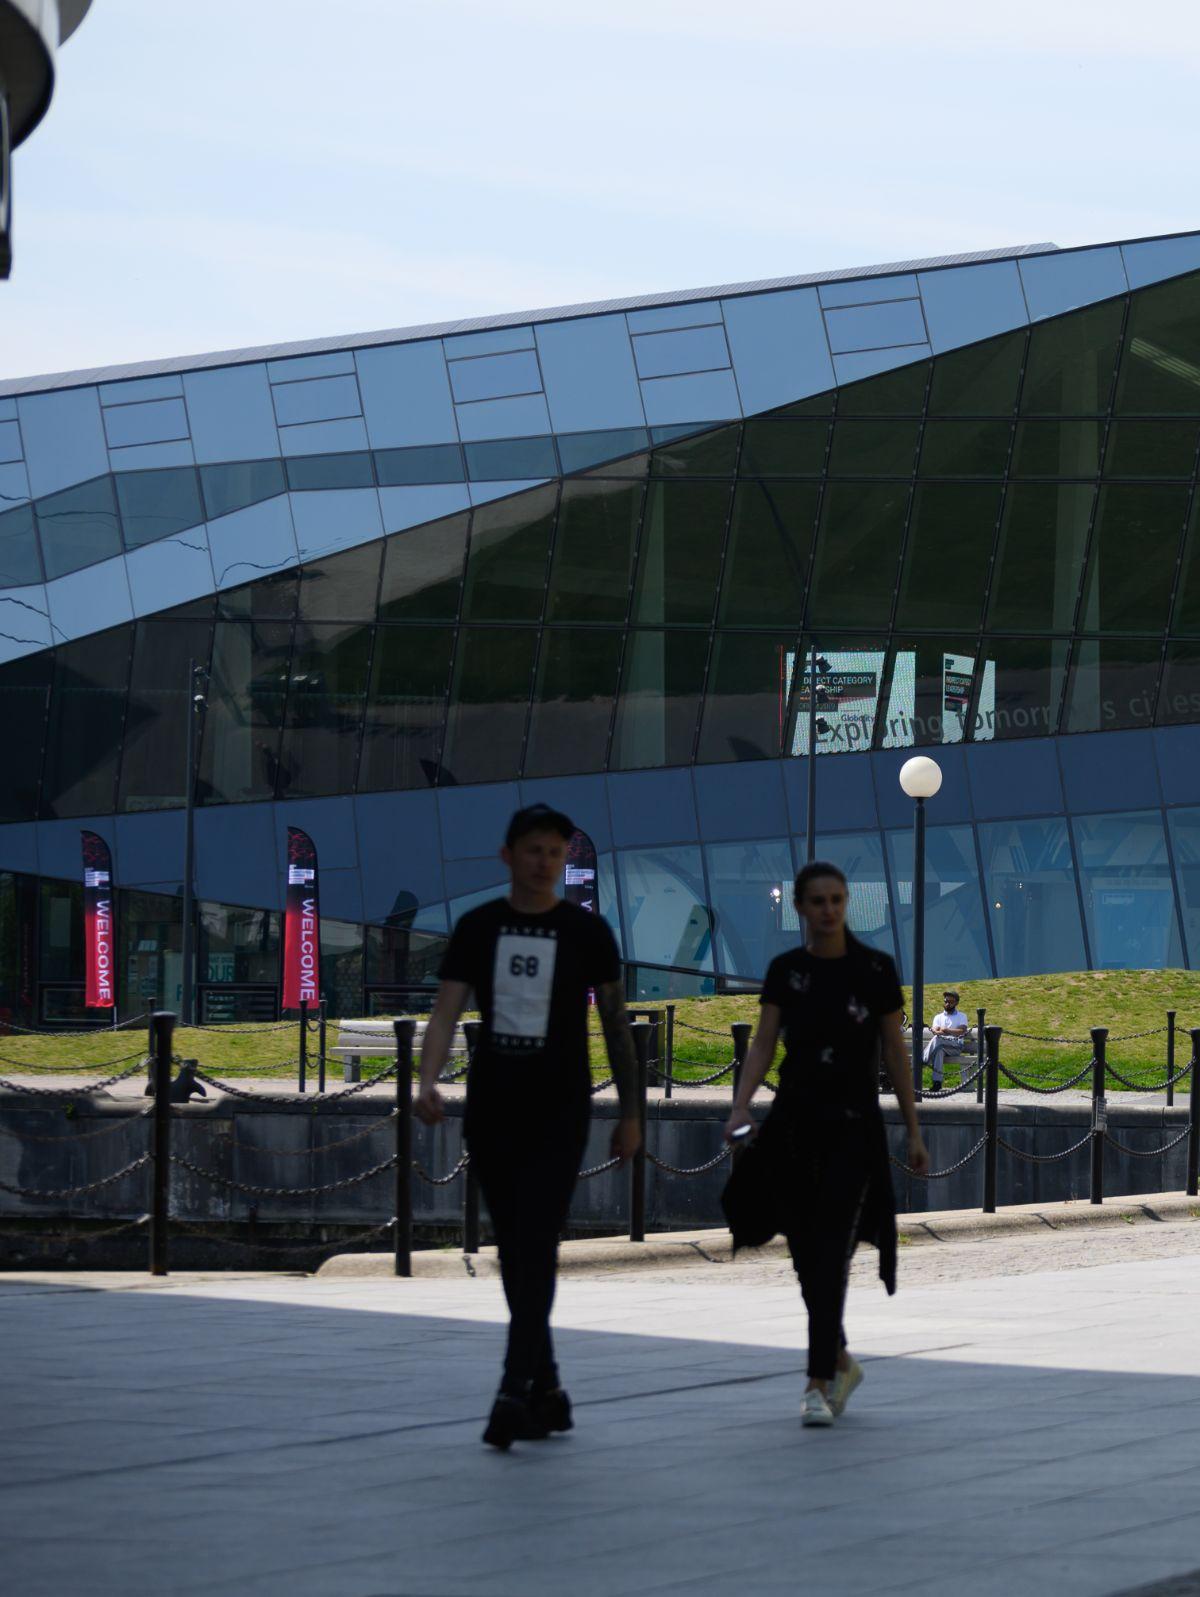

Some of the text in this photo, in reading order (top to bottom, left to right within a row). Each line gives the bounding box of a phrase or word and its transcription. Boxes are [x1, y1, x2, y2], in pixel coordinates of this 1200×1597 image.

[832, 676, 873, 685] CATEGORY
[815, 711, 944, 749] xplring
[96, 900, 111, 999] WELCOME
[300, 898, 314, 1001] WELCOME
[510, 955, 539, 977] 68
